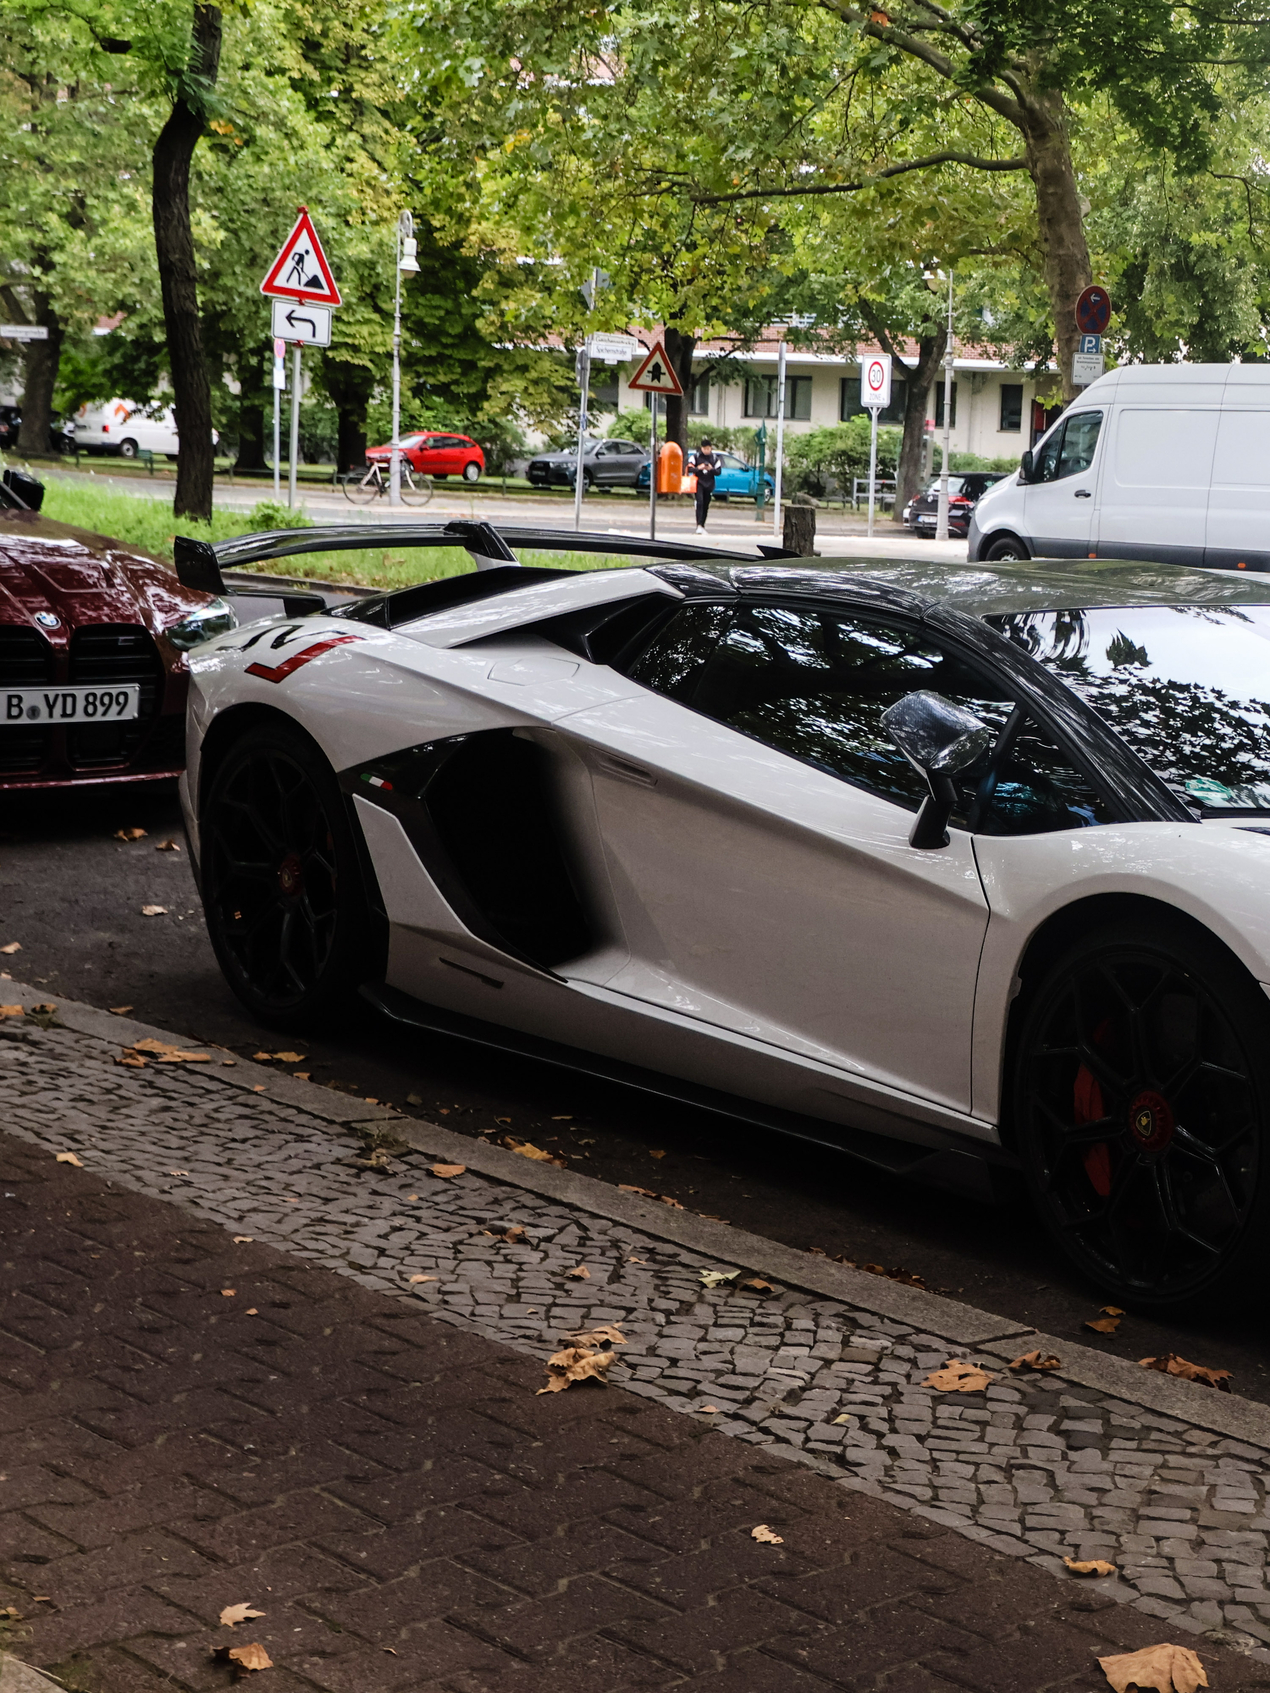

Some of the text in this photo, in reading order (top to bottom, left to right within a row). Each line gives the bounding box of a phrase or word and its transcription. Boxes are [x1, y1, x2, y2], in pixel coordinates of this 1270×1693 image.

[871, 369, 882, 383] 30
[868, 393, 882, 401] ZONE
[6, 691, 129, 720] B YD 899
